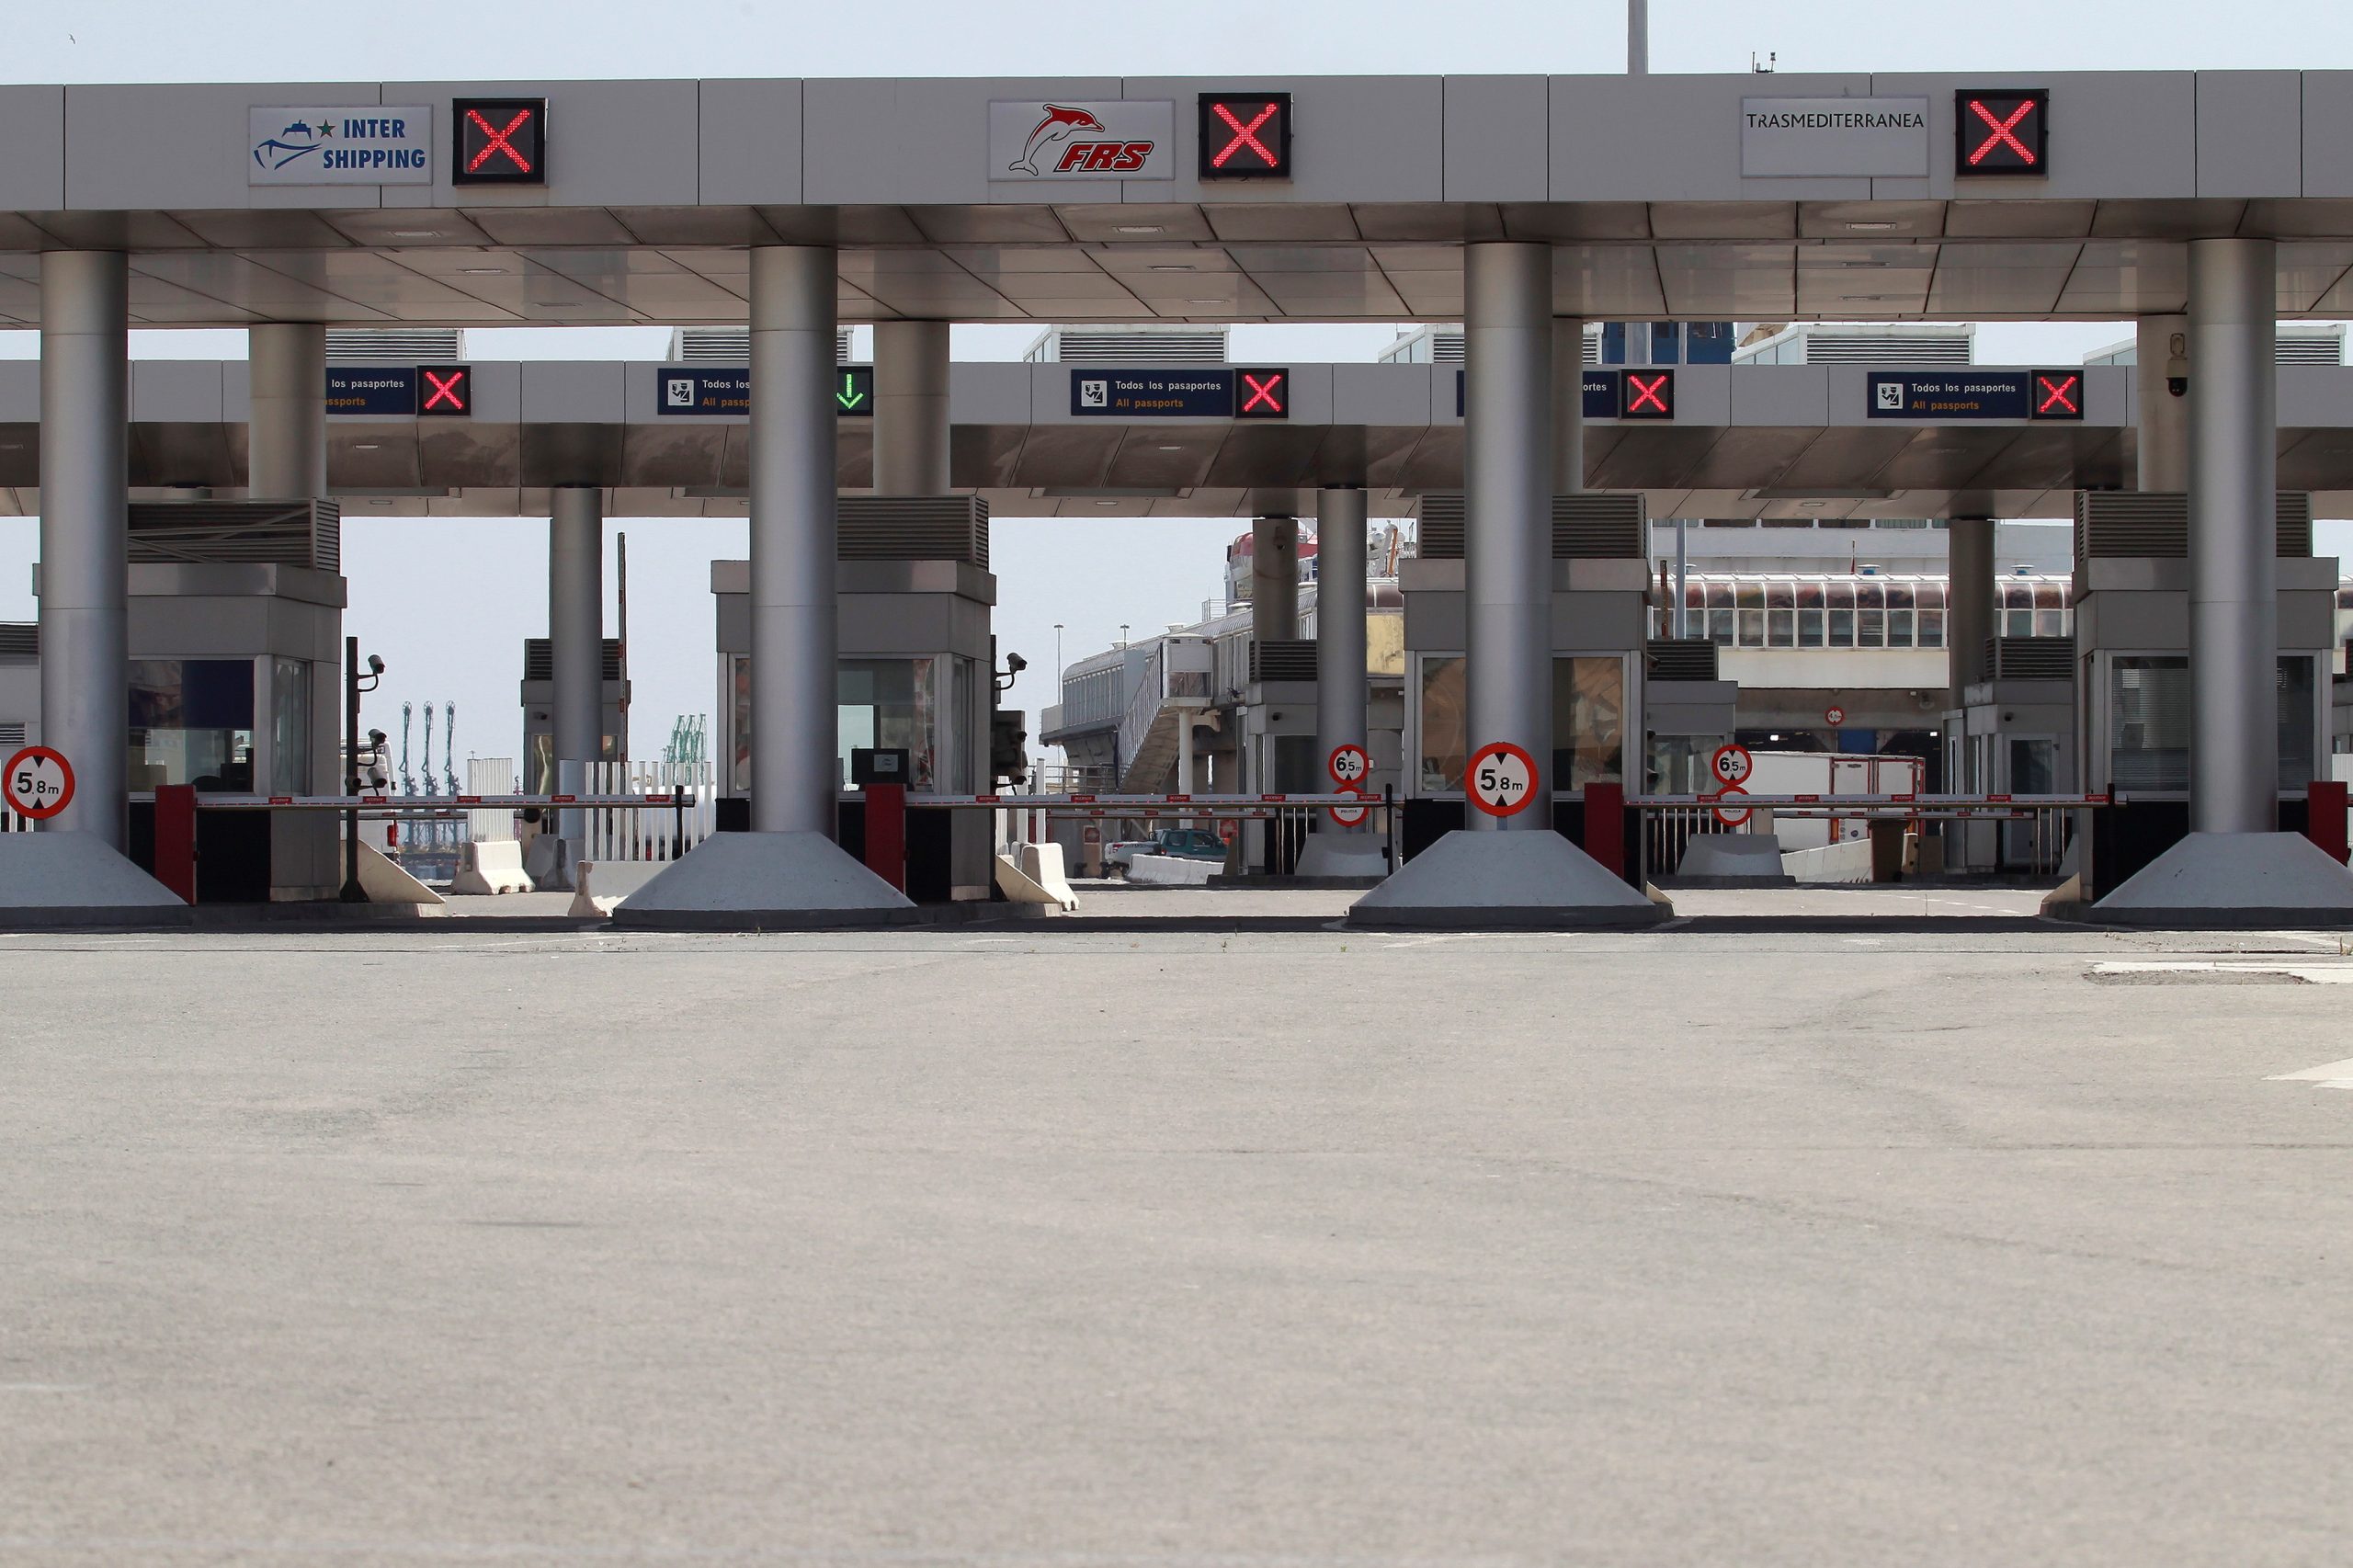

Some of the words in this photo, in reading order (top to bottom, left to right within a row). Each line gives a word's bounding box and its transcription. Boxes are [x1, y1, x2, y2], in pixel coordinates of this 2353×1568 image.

[1746, 113, 1925, 128] TRASMEDITERRANEA
[344, 119, 405, 139] INTER
[323, 149, 426, 169] SHIPPING
[1053, 141, 1154, 173] FRS
[331, 379, 347, 388] los
[351, 379, 404, 390] pasaportes
[702, 380, 732, 389] Todos
[735, 380, 750, 389] los
[1115, 381, 1143, 390] Todos
[1149, 381, 1164, 390] los
[1168, 381, 1222, 392] pasaportes
[1583, 383, 1607, 392] ortes
[1912, 383, 1940, 392] Todos
[1945, 383, 1959, 392] los
[1964, 383, 2016, 393] pasaportes
[324, 397, 366, 407] assports
[702, 397, 716, 406] All
[721, 399, 751, 408] passp
[1116, 399, 1130, 407] All
[1134, 399, 1184, 409] passports
[1913, 401, 1926, 409] All
[1931, 402, 1980, 411] passports
